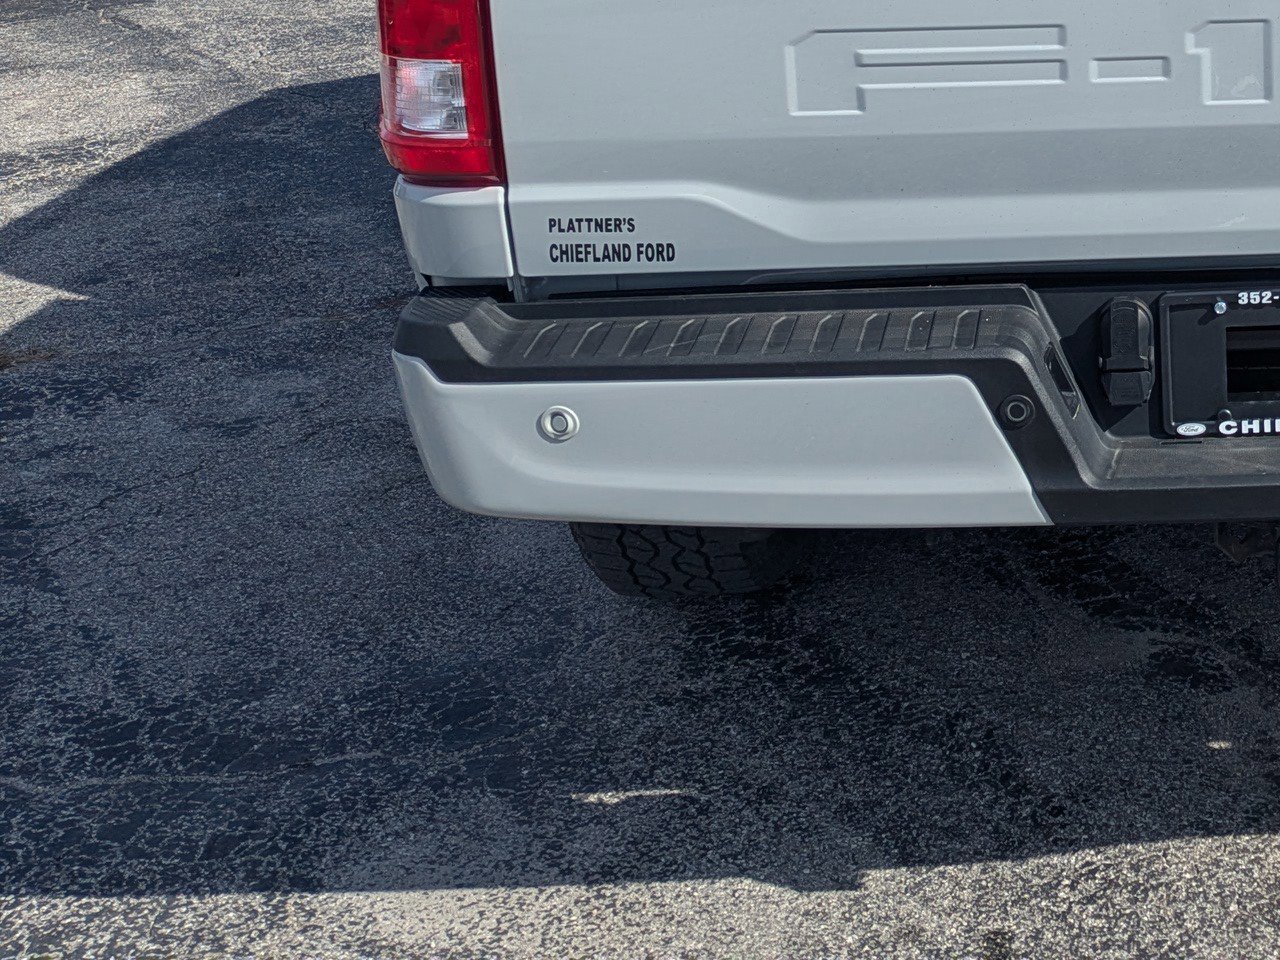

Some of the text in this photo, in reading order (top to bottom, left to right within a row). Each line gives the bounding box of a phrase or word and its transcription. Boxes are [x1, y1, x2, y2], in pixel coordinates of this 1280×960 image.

[548, 217, 636, 234] PLATTNER'S
[549, 242, 676, 263] CHIEFLAND FORD
